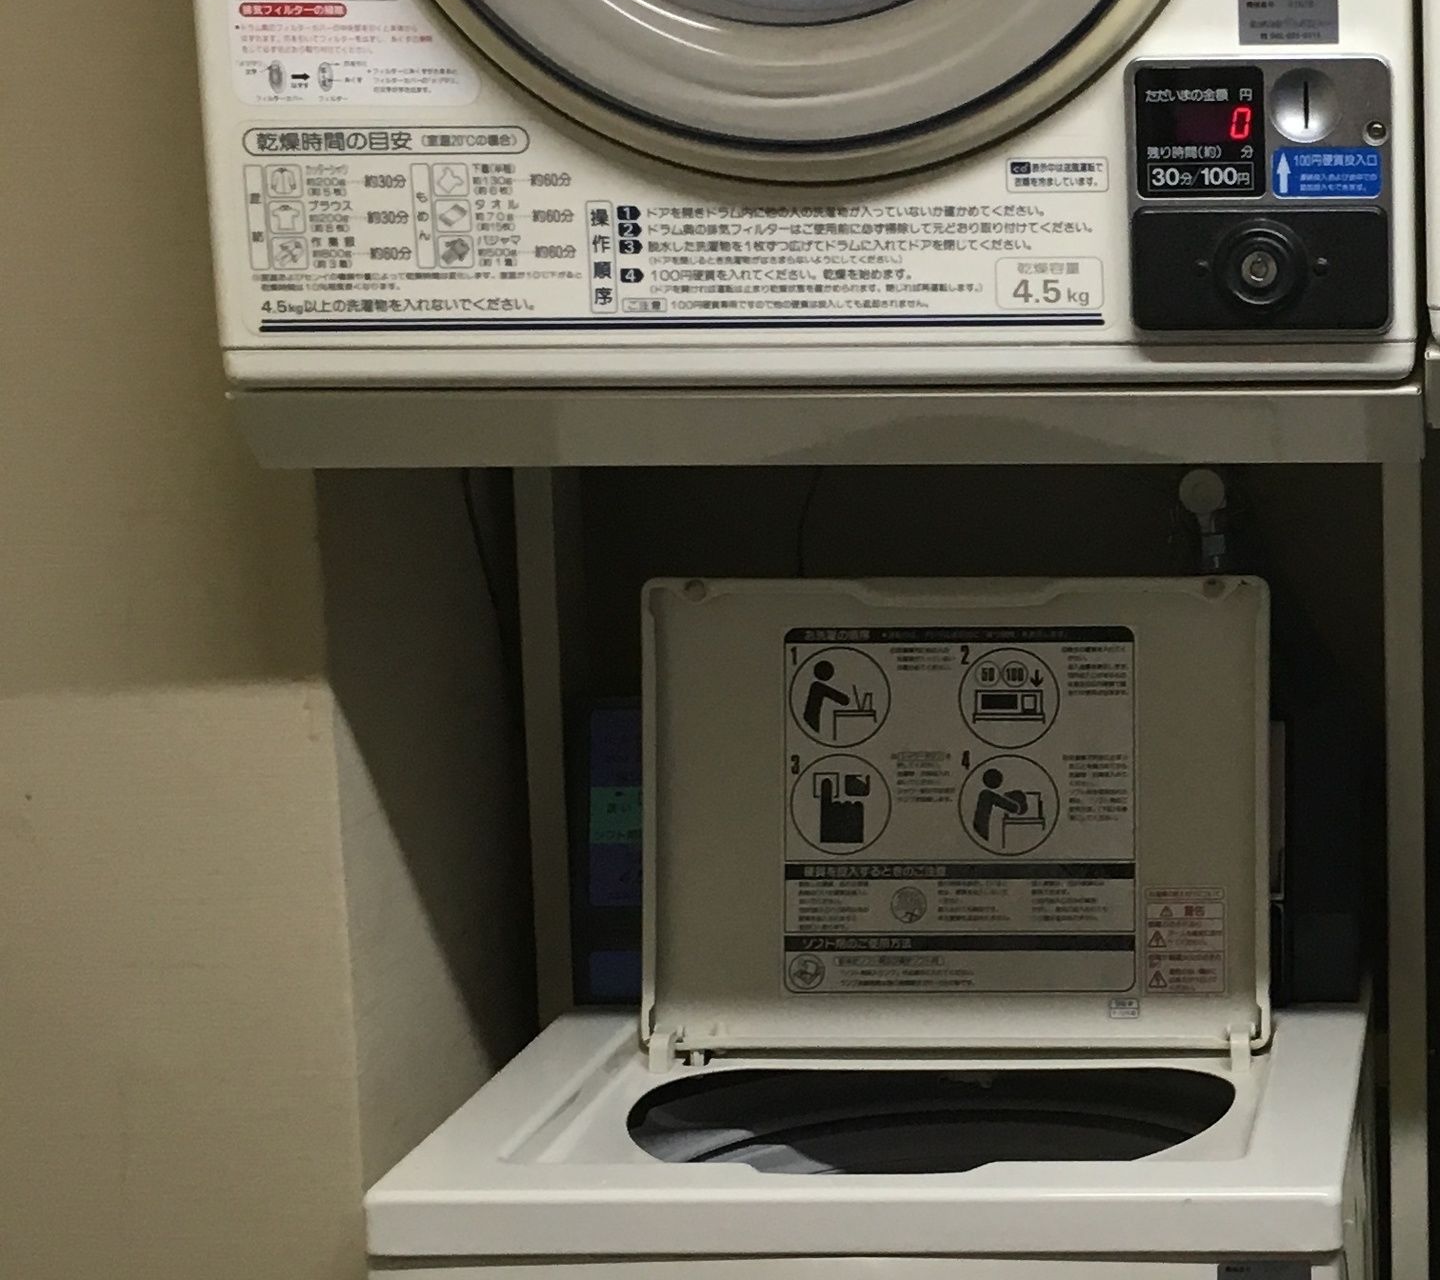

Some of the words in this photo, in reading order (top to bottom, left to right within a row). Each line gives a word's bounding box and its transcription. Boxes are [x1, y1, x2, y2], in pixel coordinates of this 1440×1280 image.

[1145, 89, 1229, 102] ただいまの金額
[1240, 88, 1253, 101] 円
[1231, 107, 1251, 139] 0
[256, 131, 413, 151] 乾燥時間の目安
[1147, 146, 1222, 159] 残り時間(約)
[1241, 146, 1253, 159] 分
[364, 175, 406, 188] 約30分
[367, 210, 409, 224] 約30分
[1012, 279, 1061, 303] 4.5
[1067, 288, 1089, 305] kg
